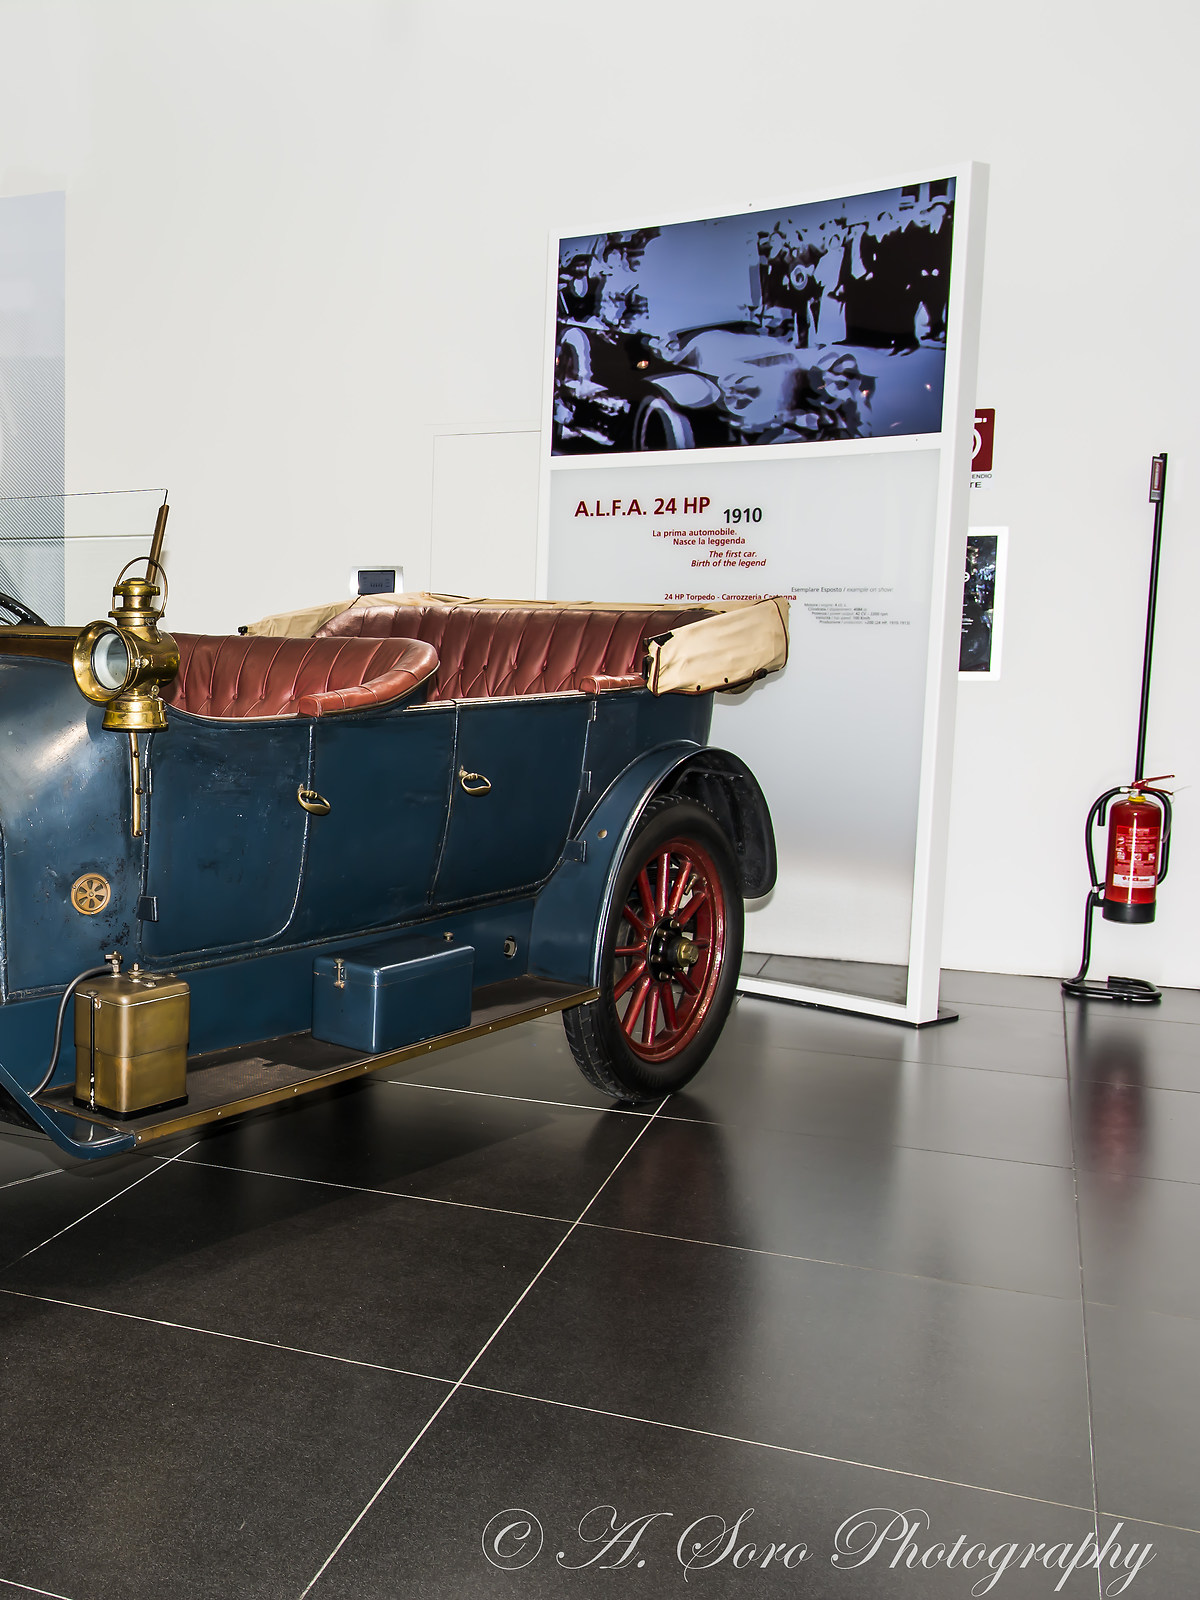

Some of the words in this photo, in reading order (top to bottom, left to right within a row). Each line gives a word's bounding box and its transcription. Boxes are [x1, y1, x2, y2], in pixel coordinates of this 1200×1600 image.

[574, 499, 647, 517] A.L.F.A.
[654, 498, 677, 515] 24
[684, 496, 711, 514] HP
[723, 507, 762, 523] 1910
[663, 529, 687, 538] prima
[689, 528, 737, 537] automobile.
[673, 538, 696, 546] Nasce
[698, 537, 706, 545] la
[708, 537, 746, 547] leggenda
[709, 550, 723, 558] The
[725, 550, 742, 558] first
[712, 560, 722, 568] of
[738, 559, 767, 569] legend
[686, 593, 716, 602] Torpedo
